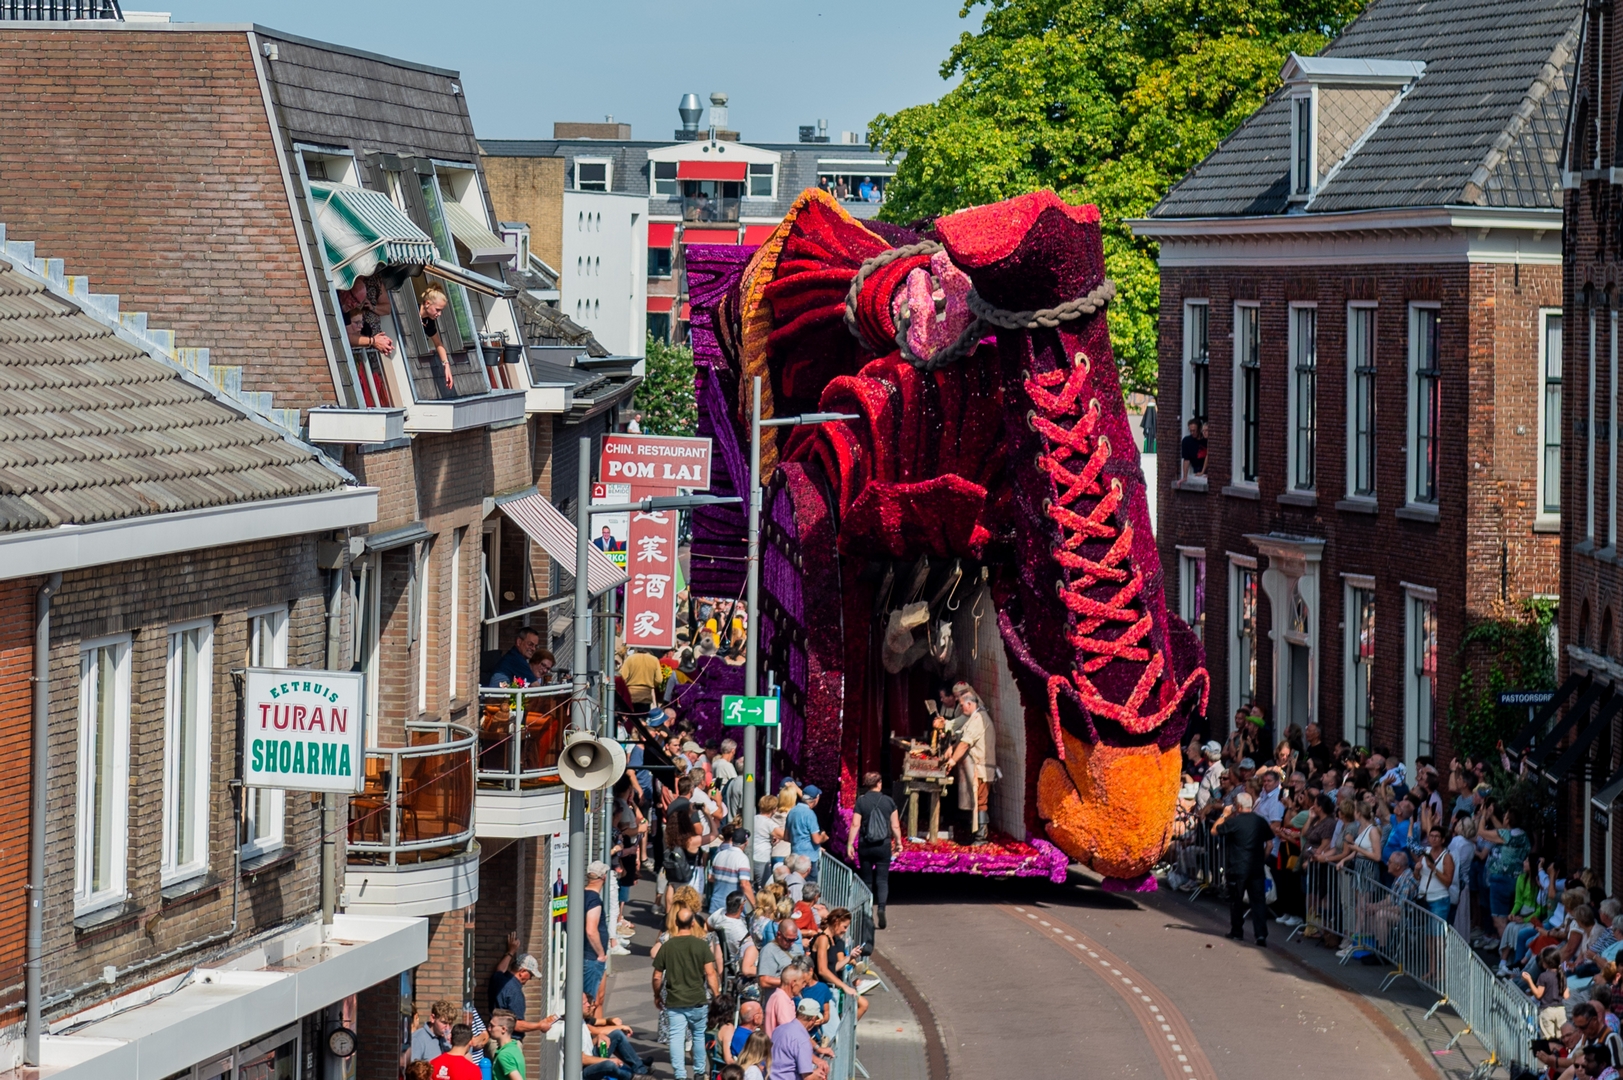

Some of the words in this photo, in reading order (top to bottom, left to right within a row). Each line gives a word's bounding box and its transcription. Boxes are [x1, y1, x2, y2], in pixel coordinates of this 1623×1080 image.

[605, 443, 634, 455] CHIN.
[637, 444, 708, 458] RESTAURANT
[608, 460, 655, 479] POM
[662, 463, 702, 481] LAI
[269, 681, 339, 703] EETHUIS
[258, 703, 348, 733] TURAN
[251, 738, 352, 777] SHOARMA
